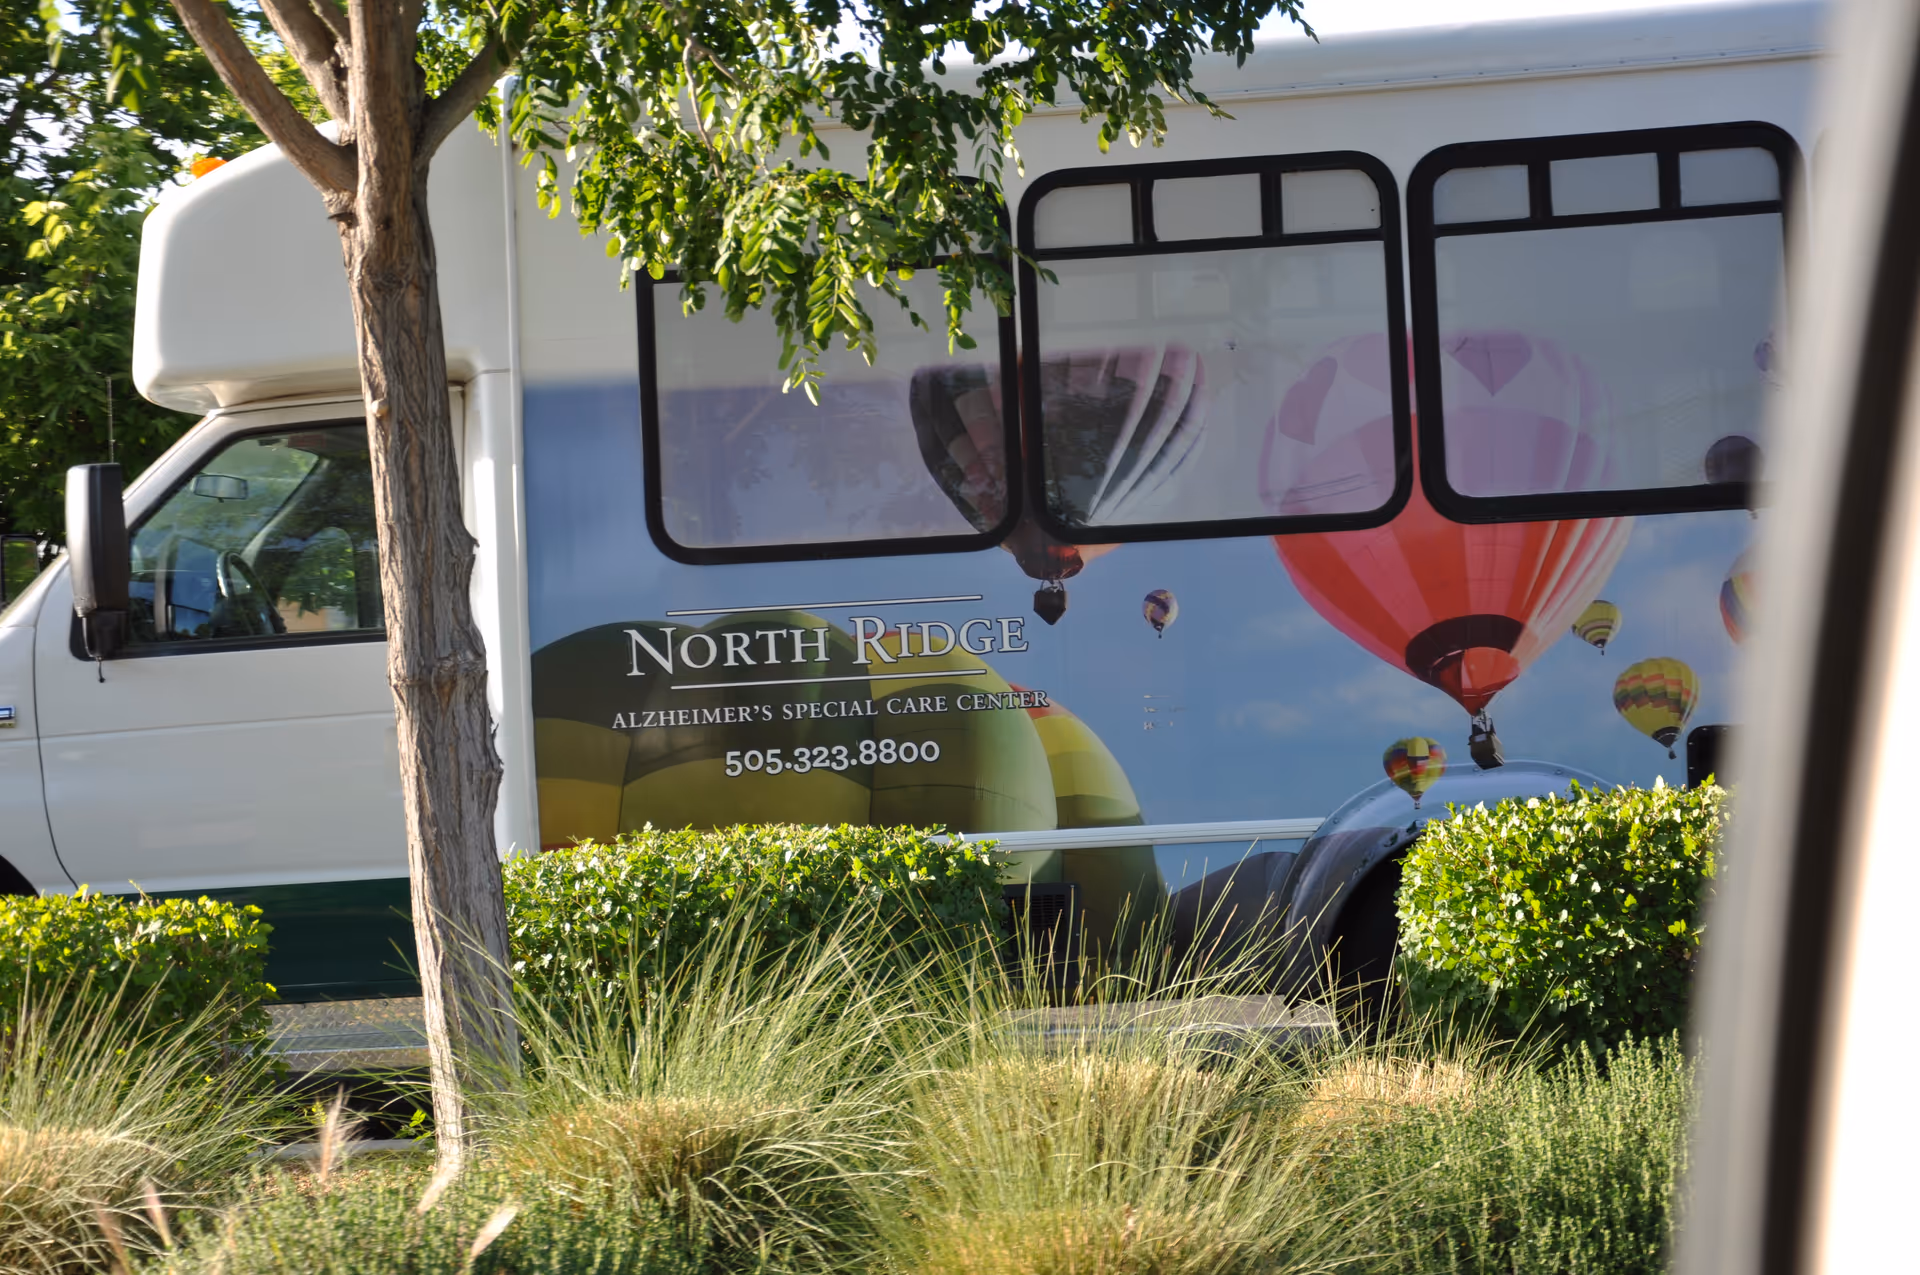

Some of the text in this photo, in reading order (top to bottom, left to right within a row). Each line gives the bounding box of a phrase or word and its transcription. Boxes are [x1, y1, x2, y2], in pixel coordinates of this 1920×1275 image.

[623, 615, 1029, 676] NORTH RIDGE
[611, 690, 1050, 729] ALZHEIMER'S SPECIAL CARE CENTER
[724, 738, 940, 777] 505.323.8800
